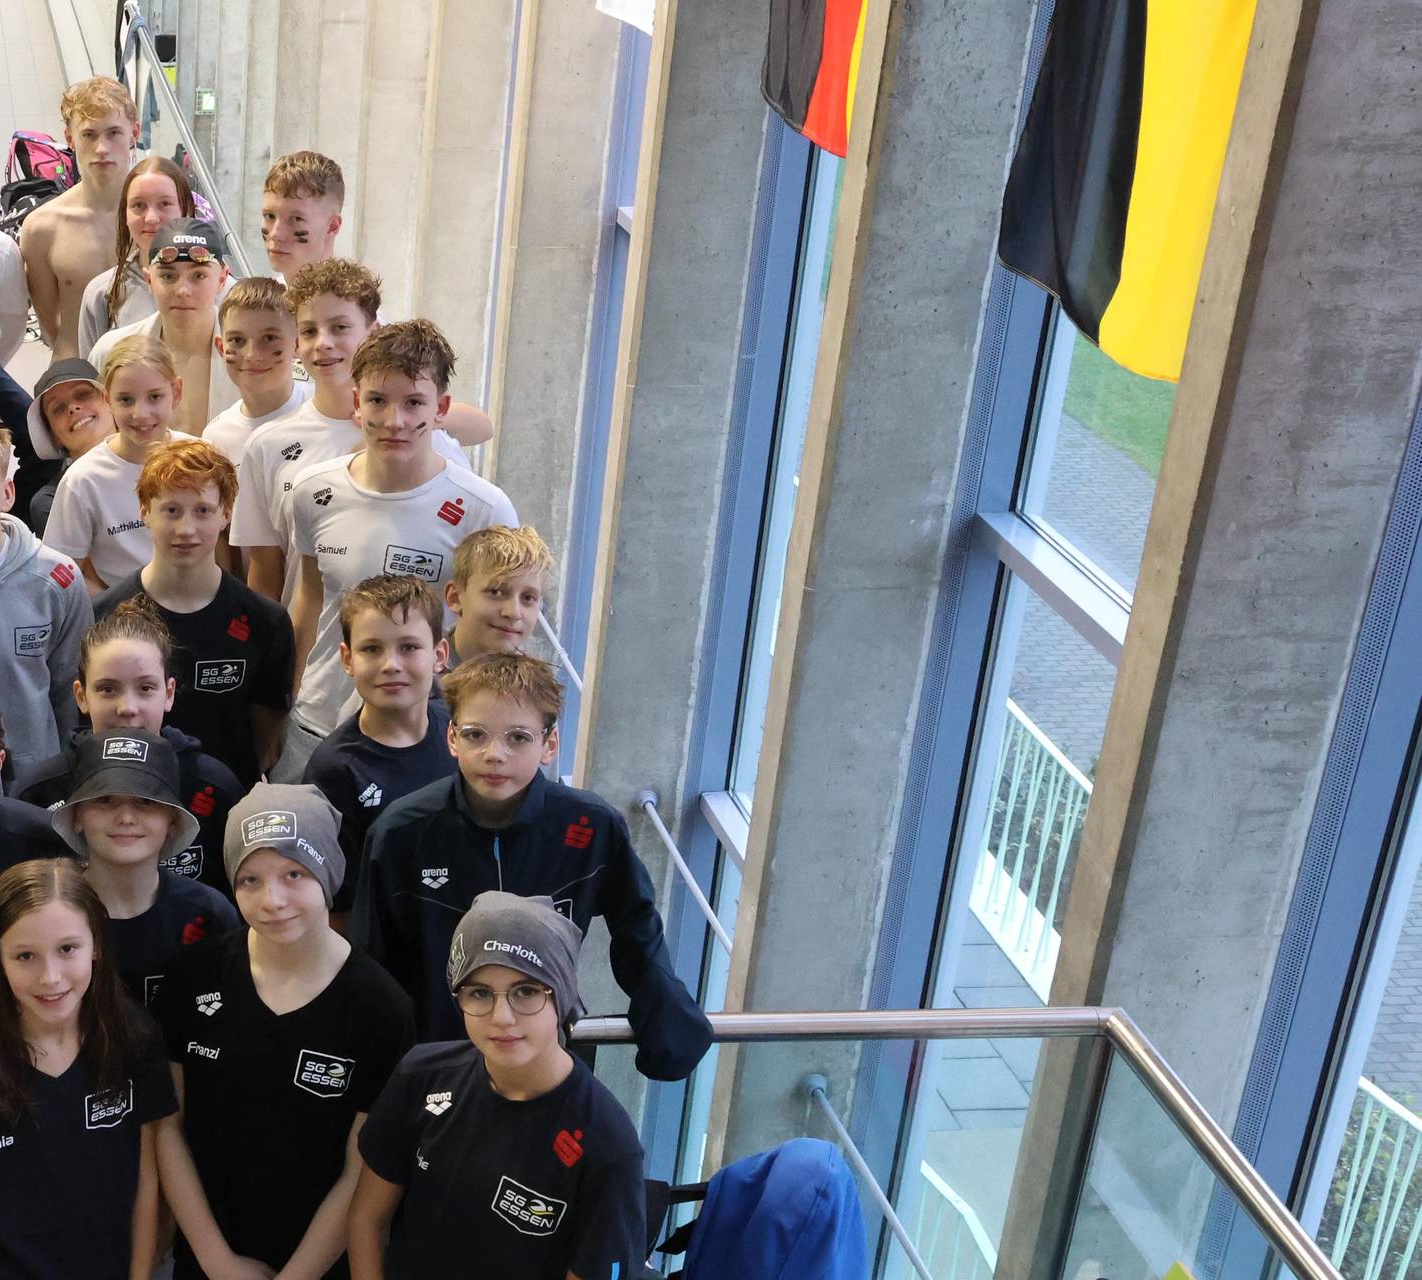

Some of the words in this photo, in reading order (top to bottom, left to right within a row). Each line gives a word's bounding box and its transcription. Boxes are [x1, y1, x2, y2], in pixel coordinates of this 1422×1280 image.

[172, 235, 207, 245] arena
[281, 442, 302, 457] arena
[312, 487, 332, 500] arena
[107, 520, 145, 536] Mathilda
[317, 544, 347, 555] Samuel
[392, 553, 411, 563] SG
[389, 562, 435, 577] ESSEN
[21, 634, 36, 642] SG
[201, 668, 219, 677] SG
[200, 676, 240, 685] ESSEN
[107, 748, 142, 757] ESSEN
[358, 782, 378, 803] arena
[248, 819, 264, 831] SG
[248, 825, 291, 839] ESSEN
[297, 838, 325, 865] Franzi
[422, 867, 448, 877] arena
[483, 940, 543, 968] Charlotte
[196, 992, 221, 1005] arena
[304, 1061, 327, 1073] SG
[301, 1071, 346, 1088] ESSEN
[426, 1091, 452, 1104] arena
[504, 1189, 527, 1206] SG
[499, 1200, 554, 1228] ESSEN
